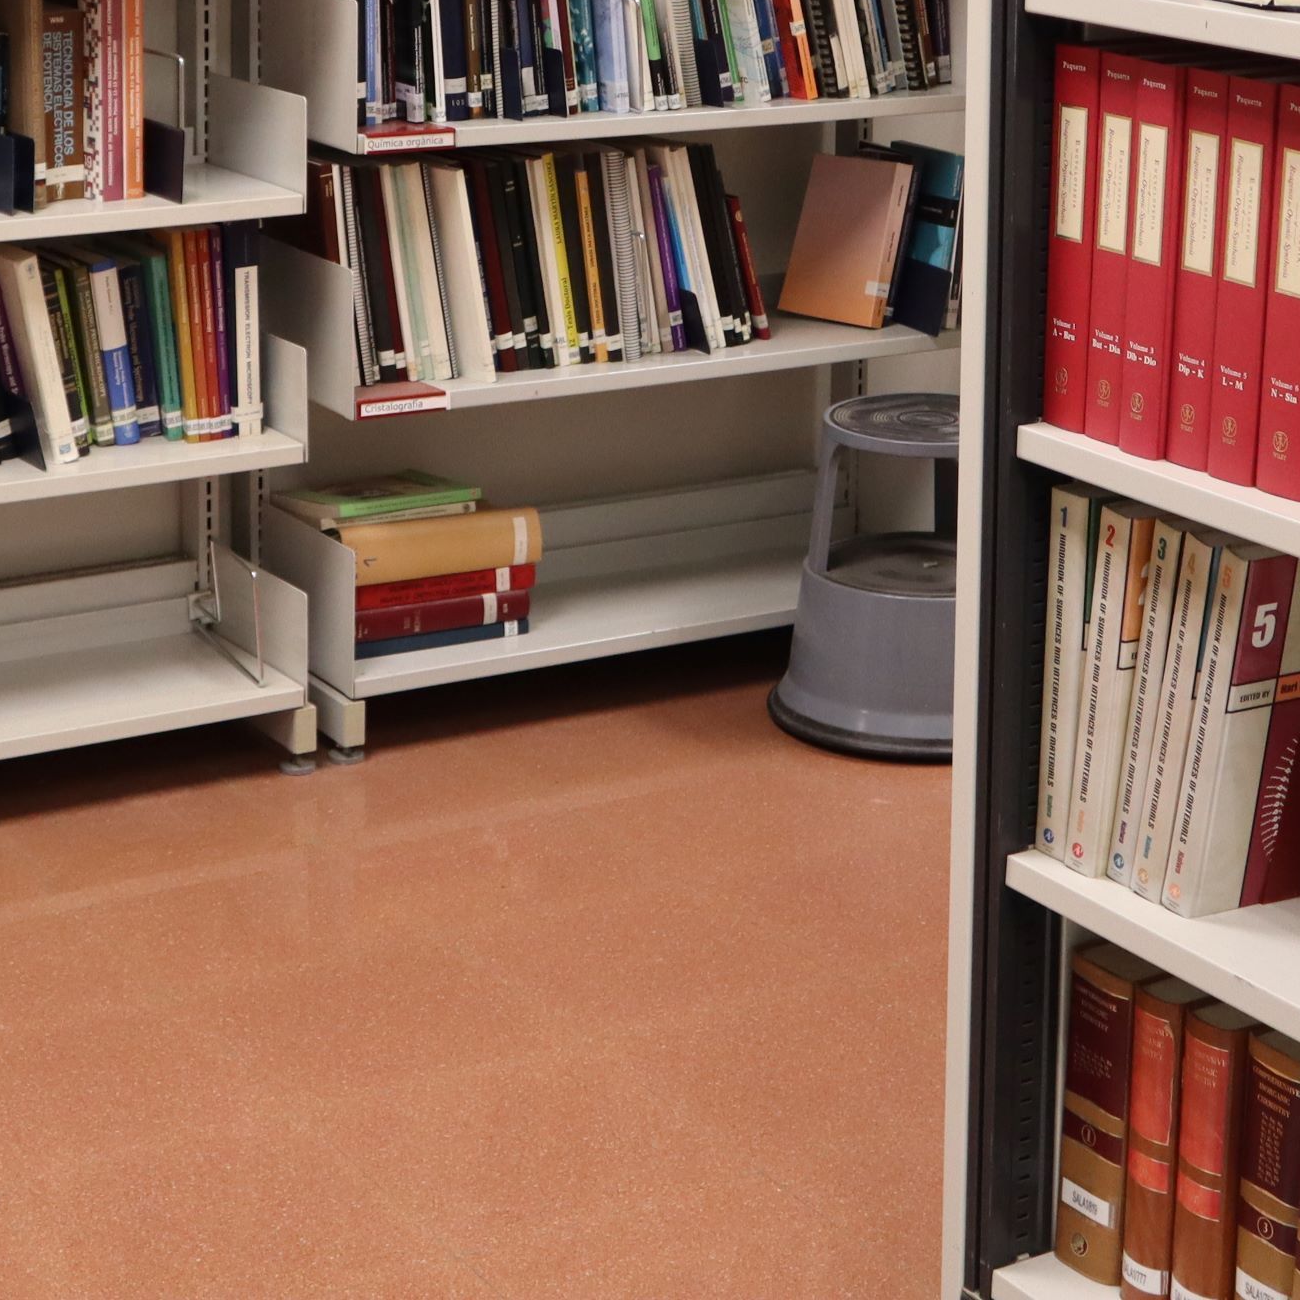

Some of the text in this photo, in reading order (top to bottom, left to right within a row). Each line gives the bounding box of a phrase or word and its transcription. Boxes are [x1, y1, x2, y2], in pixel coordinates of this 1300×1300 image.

[42, 32, 55, 113] DE POTENCIA
[52, 31, 65, 168] SISTEMAS ELECTRICOS
[61, 30, 75, 156] TECNOLOGIA DE LOS
[367, 136, 444, 151] Química orgànica
[1062, 331, 1076, 341] Bru
[1095, 329, 1113, 341] Volume
[1059, 506, 1068, 528] 1
[1105, 524, 1116, 548] 2
[1156, 538, 1168, 560] 3
[1251, 602, 1279, 649] 5
[1252, 1064, 1300, 1098] COMPREHENSIVE
